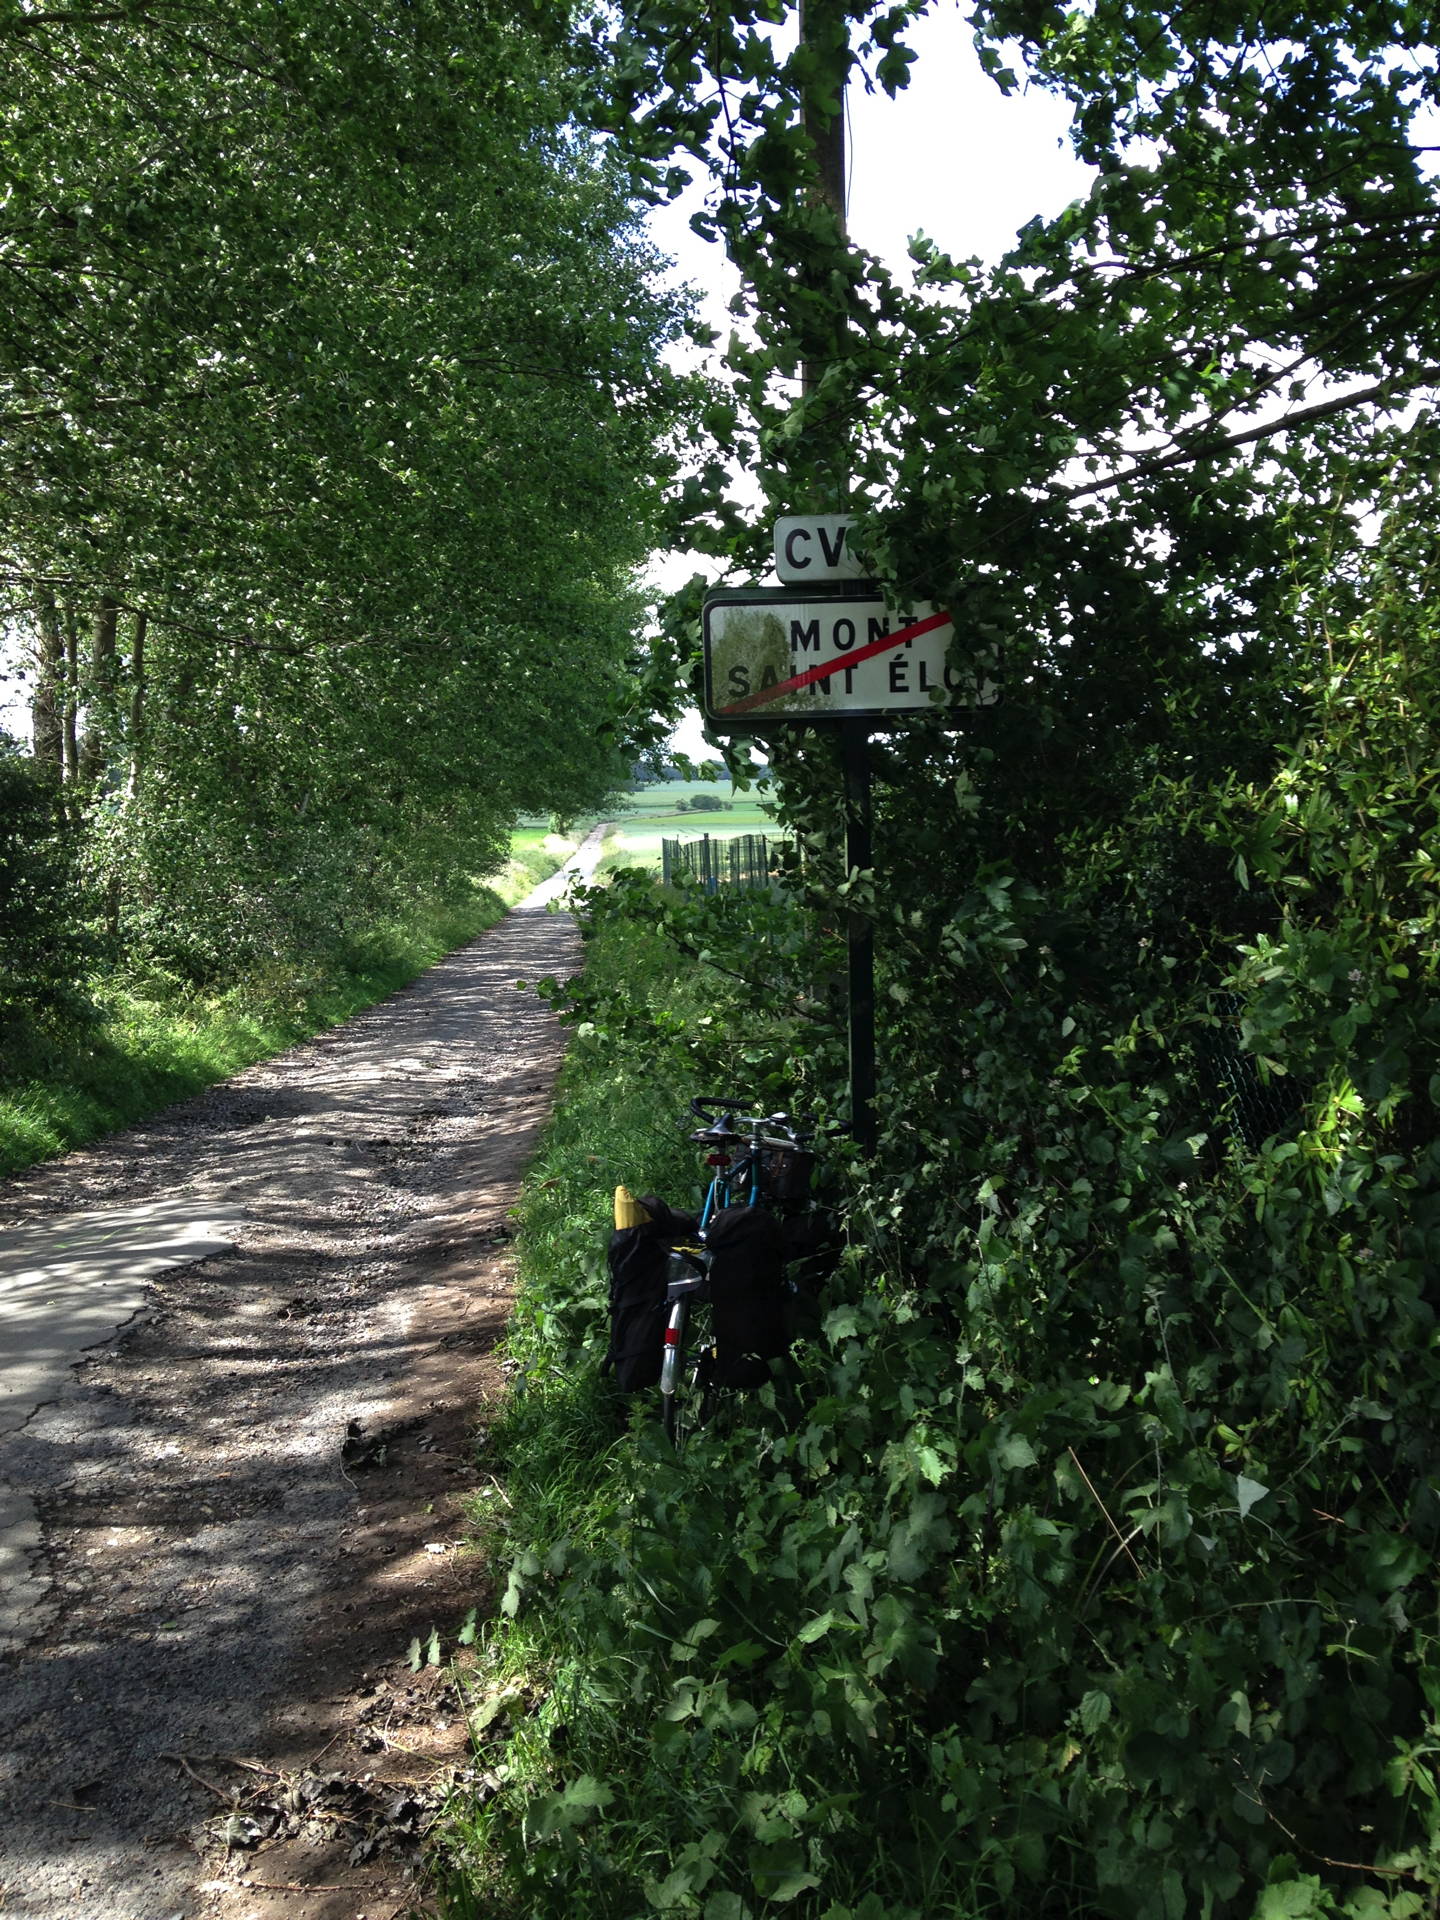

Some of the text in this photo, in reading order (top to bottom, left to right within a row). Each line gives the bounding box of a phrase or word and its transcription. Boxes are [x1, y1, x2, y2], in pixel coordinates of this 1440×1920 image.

[785, 527, 868, 569] CV
[791, 617, 918, 652] MONT
[728, 662, 858, 697] SAINT
